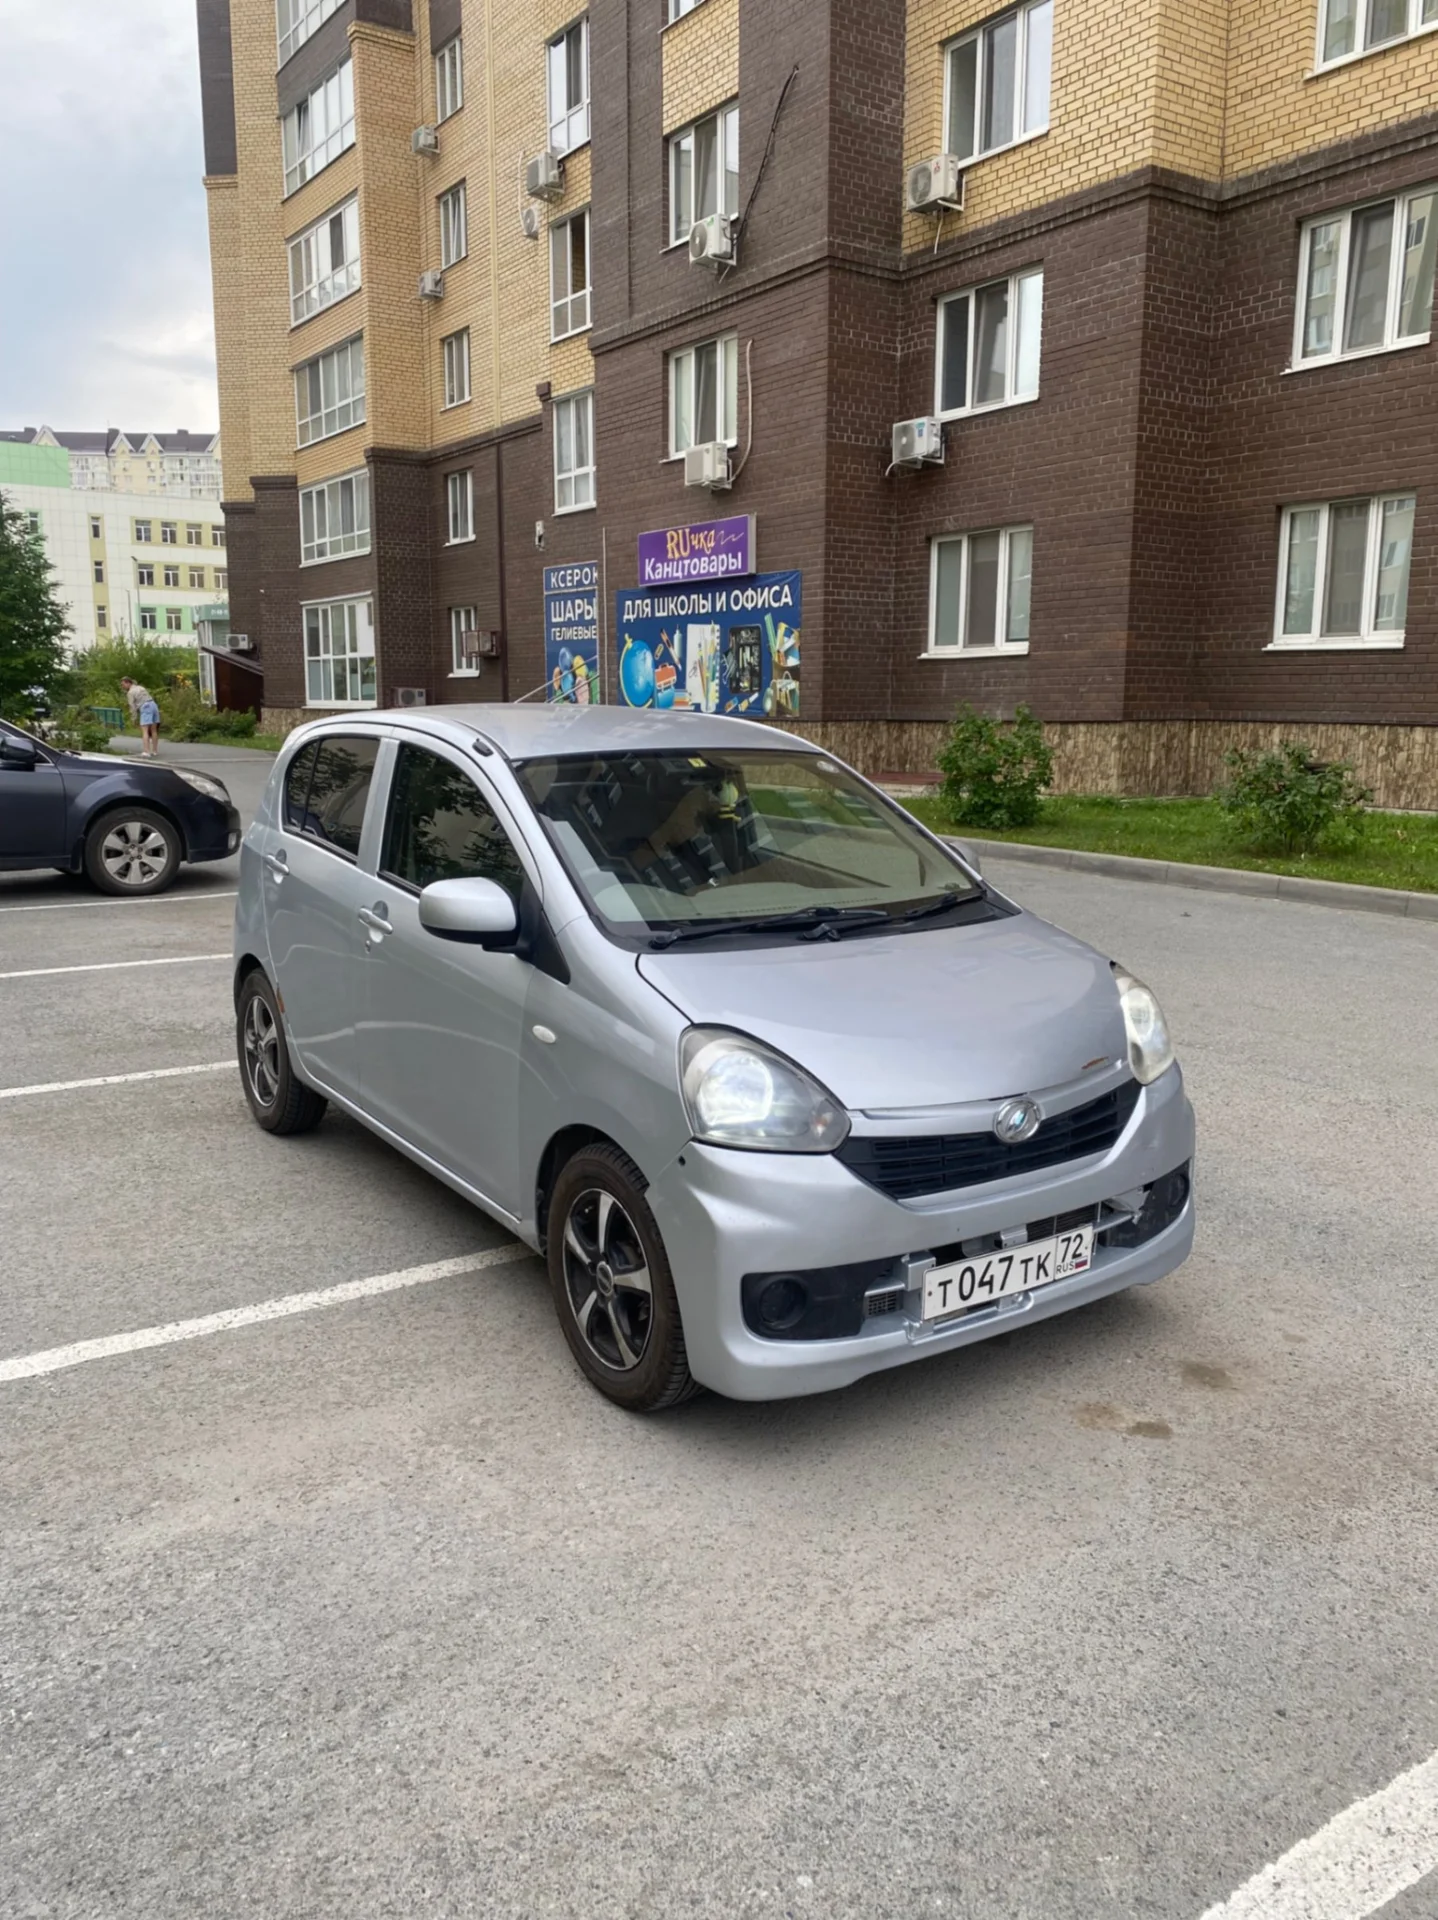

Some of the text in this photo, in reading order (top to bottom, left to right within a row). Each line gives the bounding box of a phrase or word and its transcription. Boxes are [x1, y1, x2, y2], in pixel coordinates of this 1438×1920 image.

[645, 551, 742, 581] Канцтовары
[550, 598, 597, 623] ШАРЫ
[623, 584, 793, 623] ДЛЯ ШКОЛЫ И ОФИСА
[551, 625, 598, 641] ГЕЛИЕВЫЕ
[1060, 1232, 1084, 1264] 72
[1056, 1262, 1075, 1275] RUS
